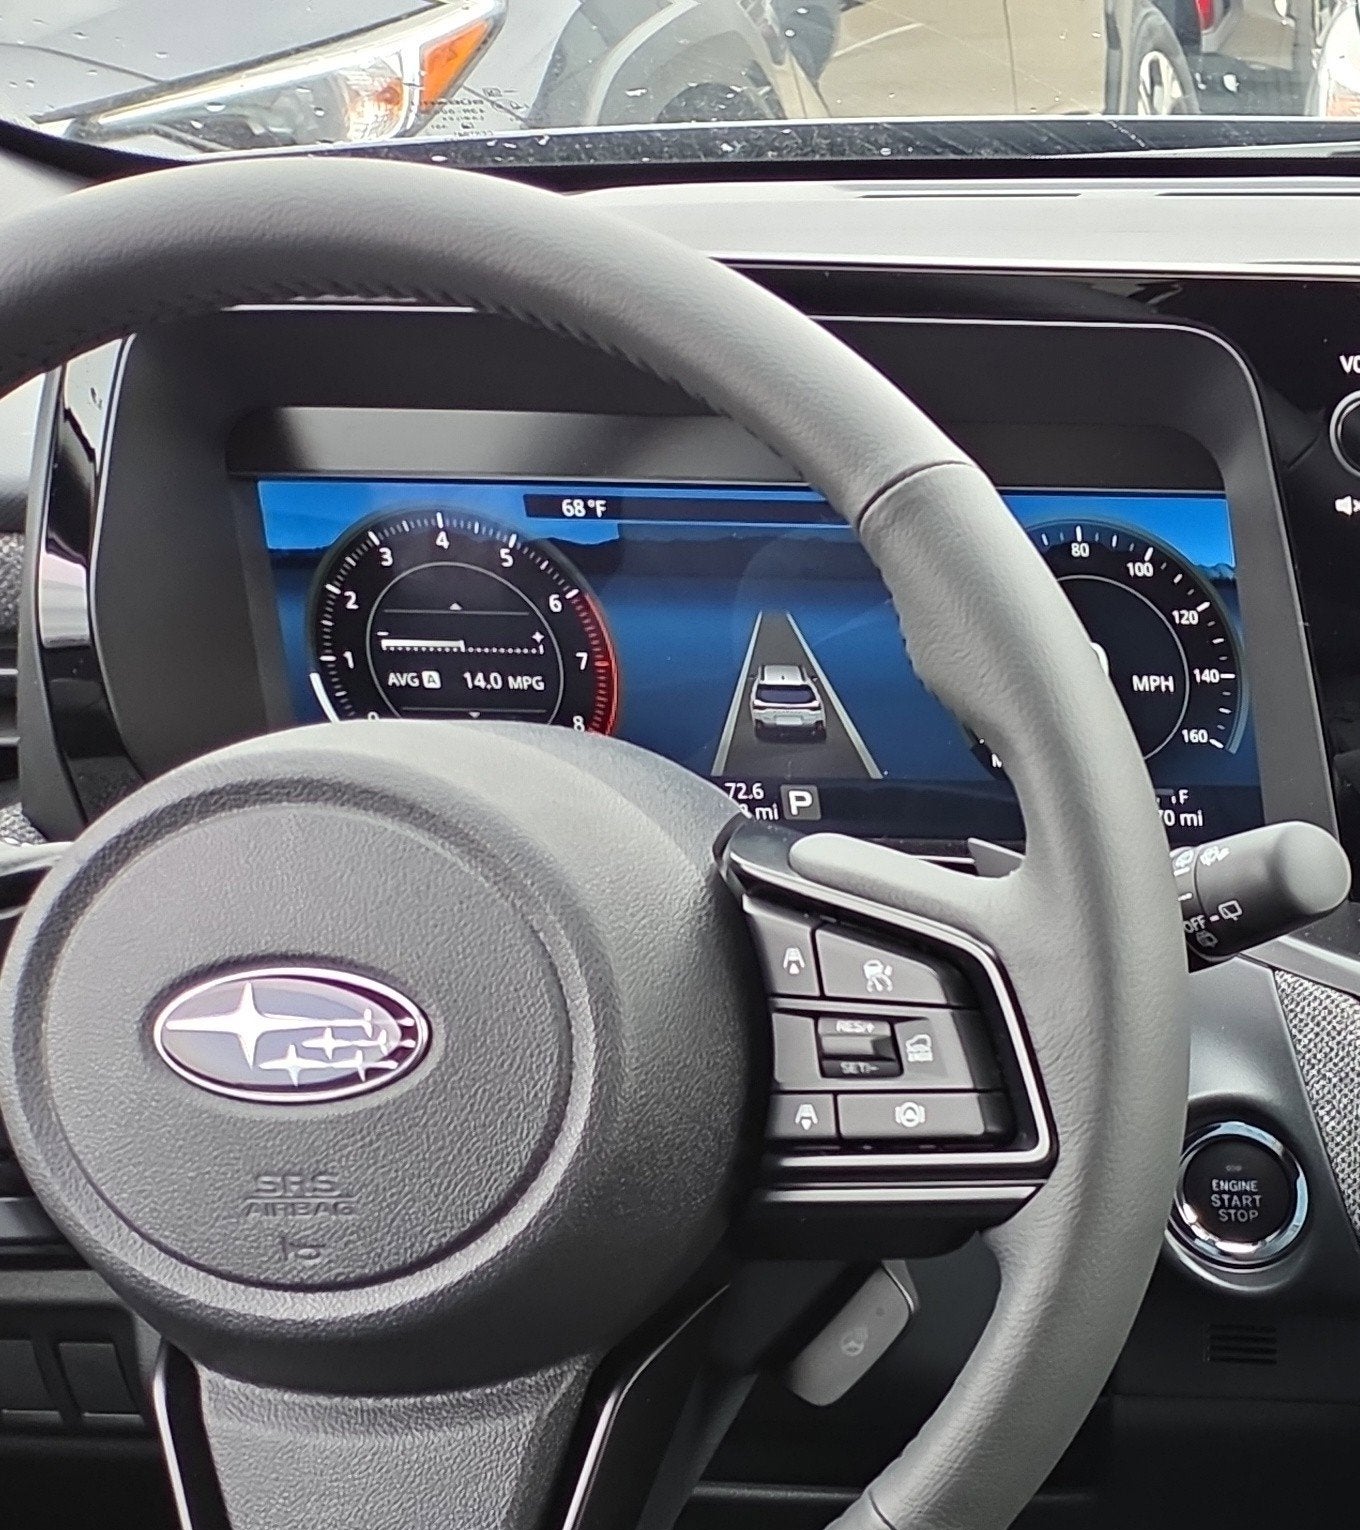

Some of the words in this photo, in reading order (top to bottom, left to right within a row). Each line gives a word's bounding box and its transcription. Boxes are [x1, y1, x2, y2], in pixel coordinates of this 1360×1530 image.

[561, 499, 607, 518] 68°F
[435, 532, 450, 550] 4
[1071, 542, 1089, 558] 80
[379, 547, 394, 567] 3
[499, 549, 514, 567] 5
[1126, 561, 1154, 577] 100
[344, 591, 359, 610] 2
[548, 594, 563, 612] 6
[1172, 609, 1199, 626] 120
[343, 651, 355, 670] 1
[575, 652, 588, 670] 7
[387, 672, 419, 687] AVG
[463, 672, 502, 690] 14.0
[508, 675, 545, 690] MPG
[1132, 675, 1175, 694] MPH
[1193, 668, 1220, 684] 140
[572, 714, 586, 732] 8
[1182, 729, 1208, 744] 160
[724, 782, 764, 799] 72.6
[755, 802, 779, 820] mi
[788, 790, 813, 815] P
[1180, 809, 1203, 827] mi
[1182, 915, 1205, 933] OFF
[254, 1173, 342, 1197] SRS
[1211, 1178, 1258, 1192] ENGINE
[242, 1201, 357, 1218] AIRBAG
[1211, 1194, 1262, 1207] START
[1218, 1209, 1259, 1222] STOP
